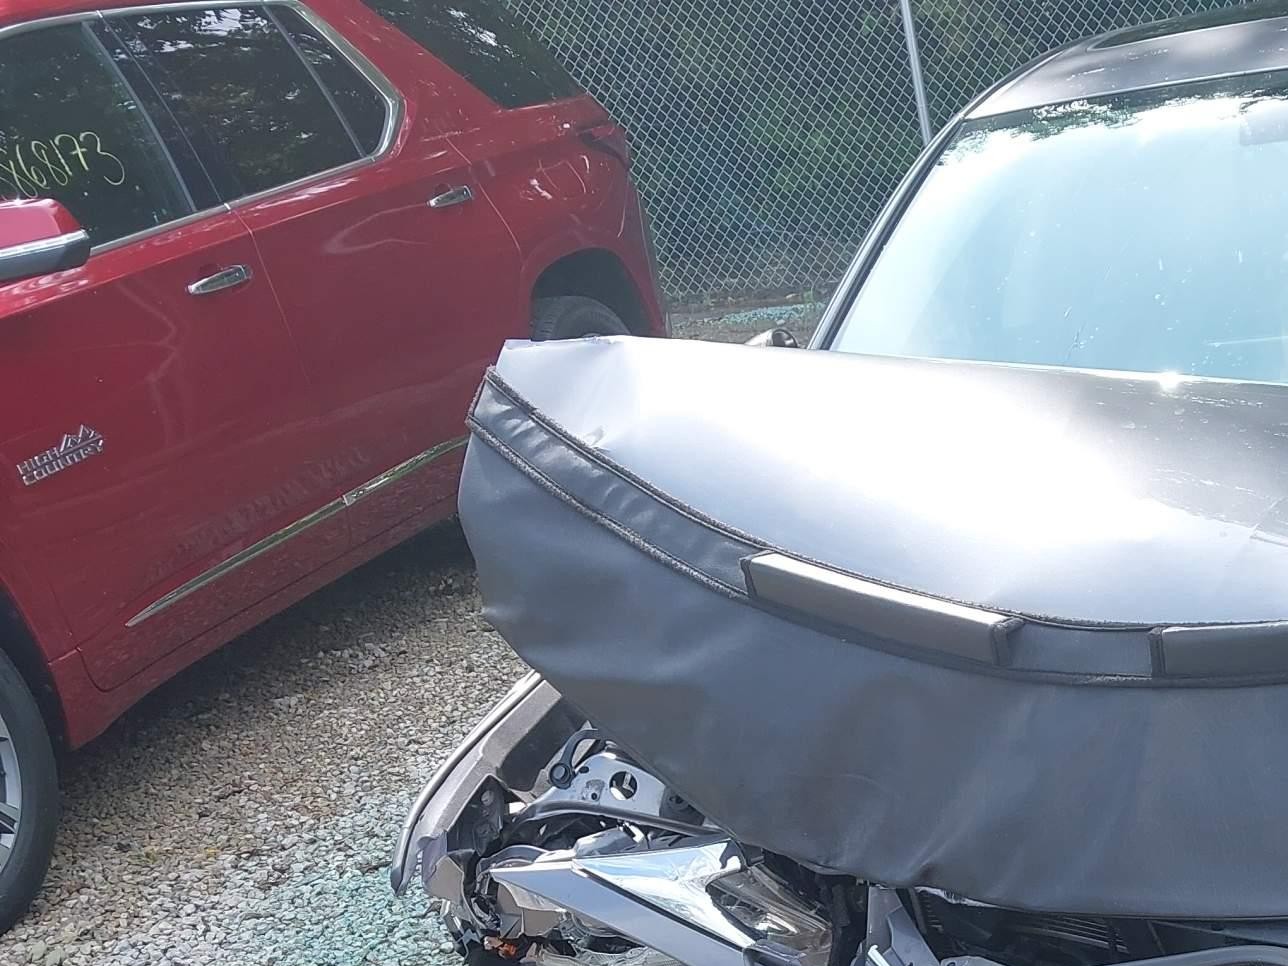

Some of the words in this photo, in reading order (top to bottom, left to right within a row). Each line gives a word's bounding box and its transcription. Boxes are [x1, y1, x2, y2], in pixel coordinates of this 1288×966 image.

[0, 131, 126, 199] 868173
[16, 446, 60, 475] HIGH
[22, 439, 104, 486] COUNTRY
